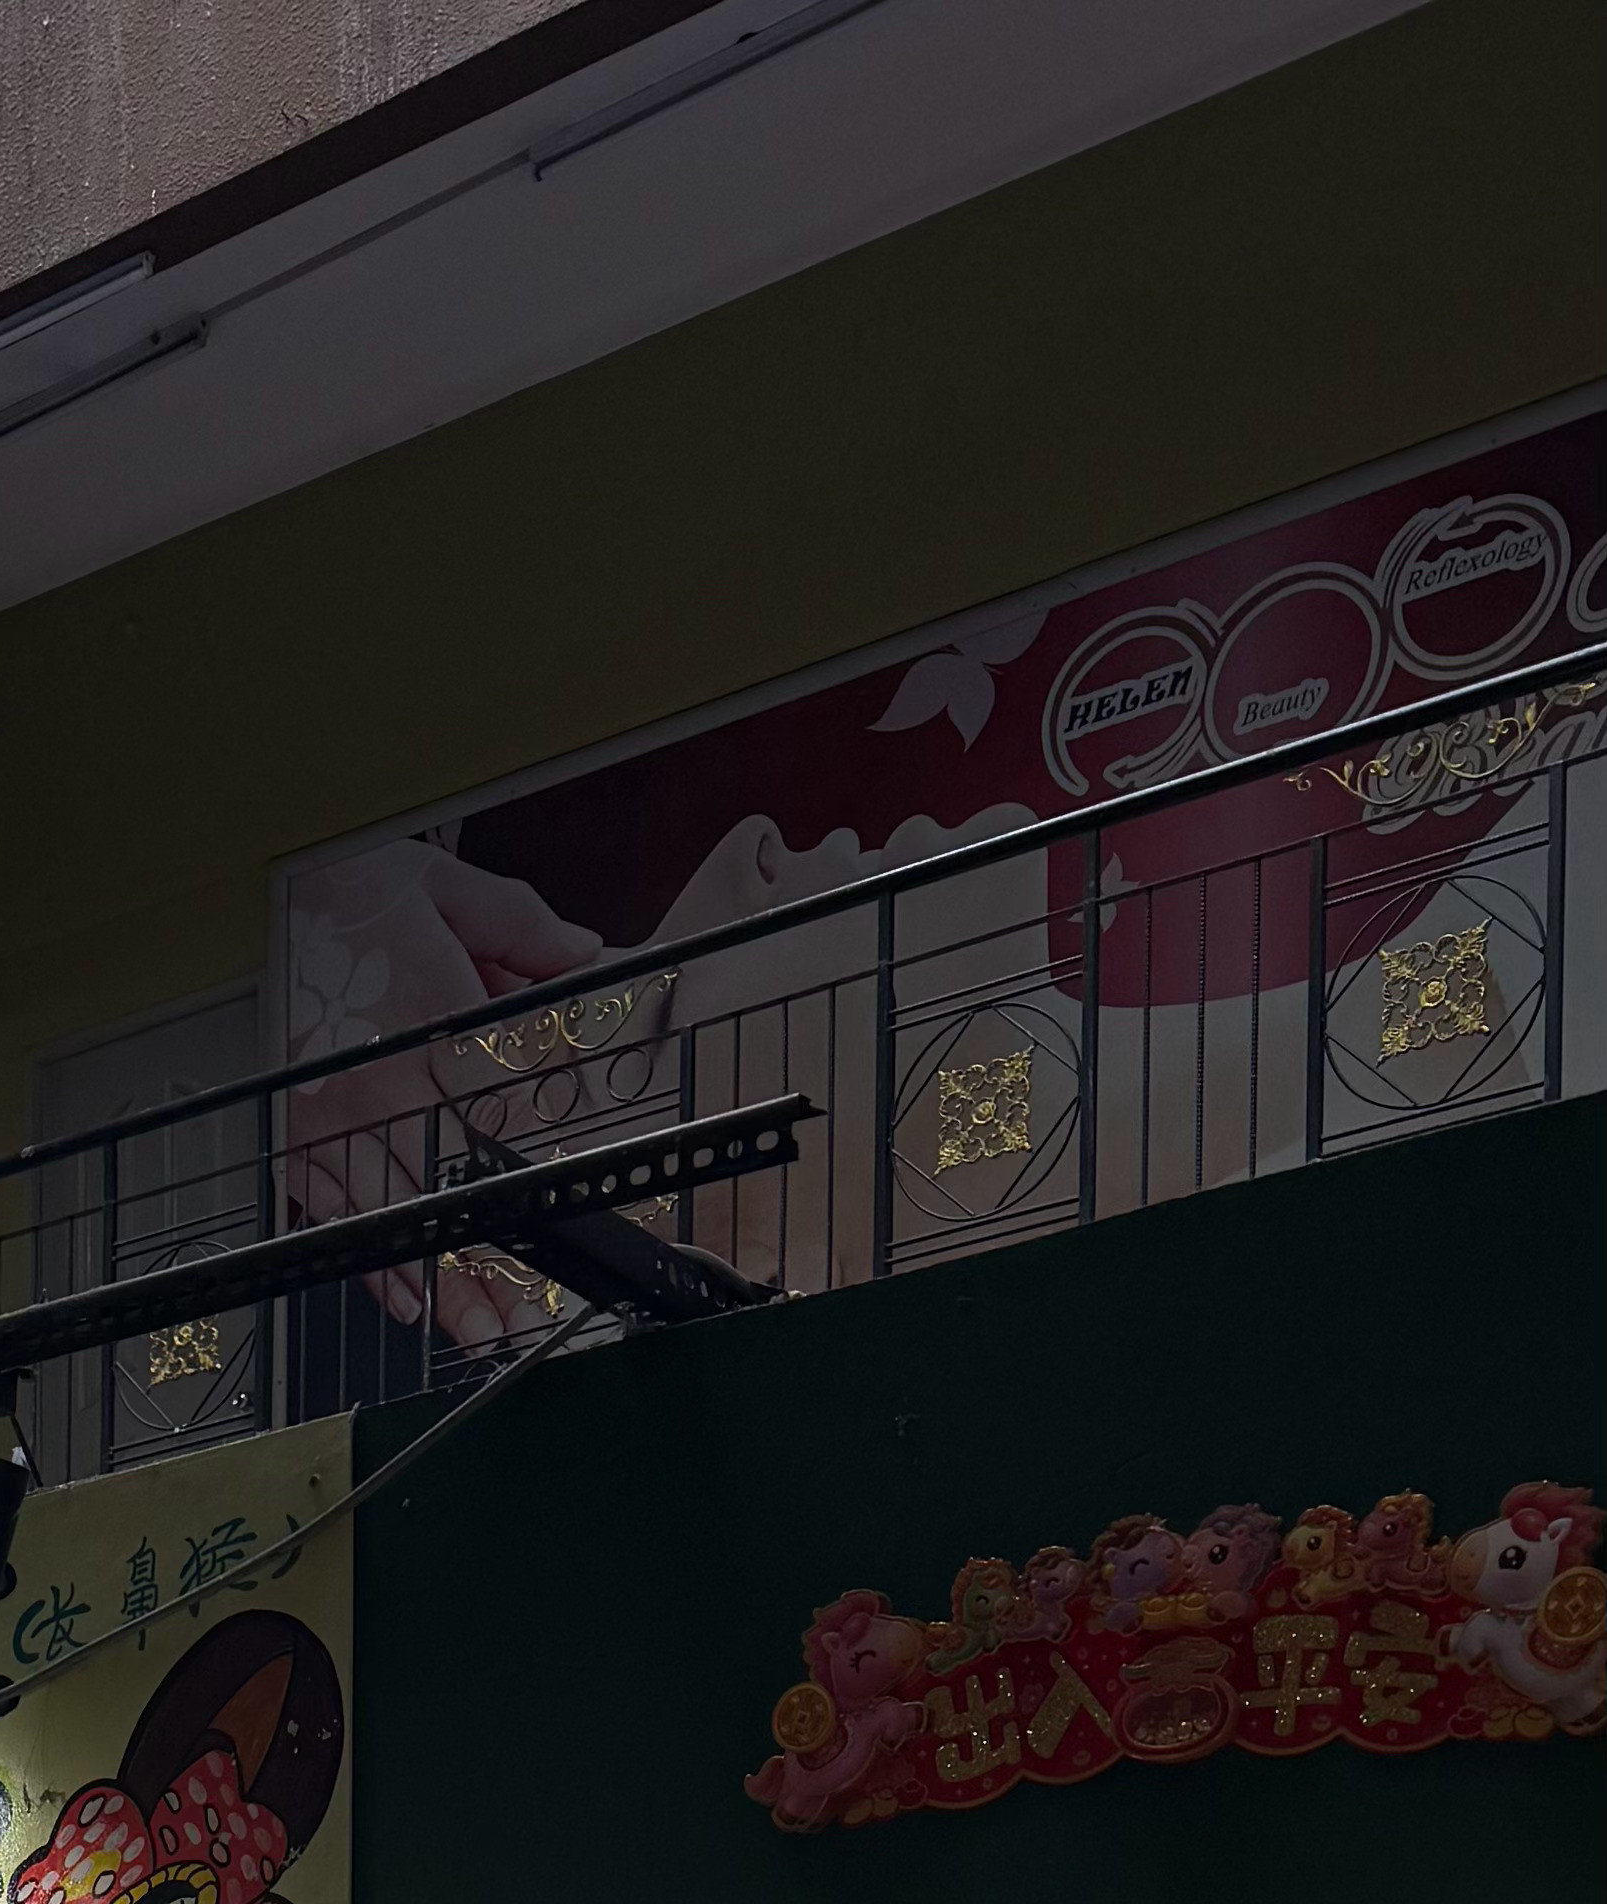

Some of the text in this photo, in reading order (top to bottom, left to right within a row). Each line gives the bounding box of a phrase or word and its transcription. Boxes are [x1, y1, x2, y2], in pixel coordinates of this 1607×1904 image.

[1404, 533, 1546, 594] Reflexology
[1065, 665, 1193, 732] HELEN
[1242, 686, 1322, 727] Beauty
[923, 1600, 1447, 1784] 出入平安
